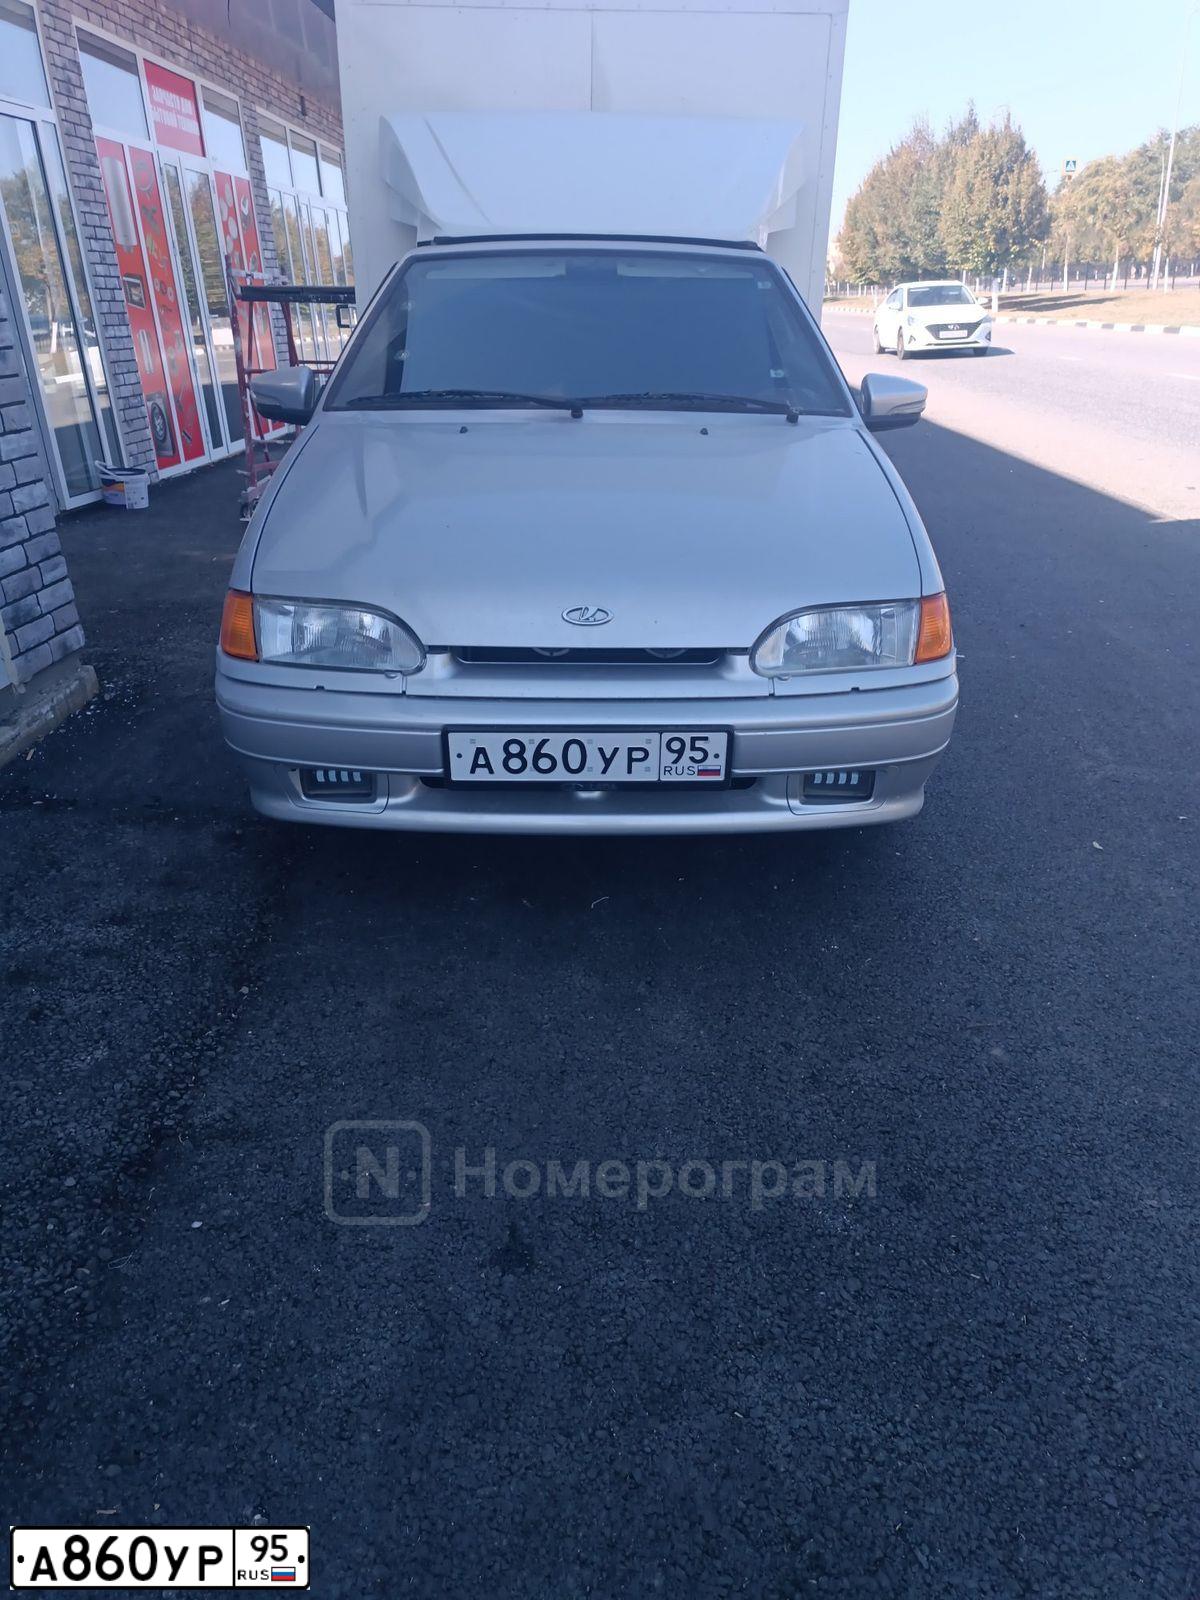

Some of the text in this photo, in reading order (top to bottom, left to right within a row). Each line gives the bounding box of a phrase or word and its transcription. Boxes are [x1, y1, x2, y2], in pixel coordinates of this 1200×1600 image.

[469, 736, 709, 774] А860УР 95
[663, 765, 696, 776] RUS
